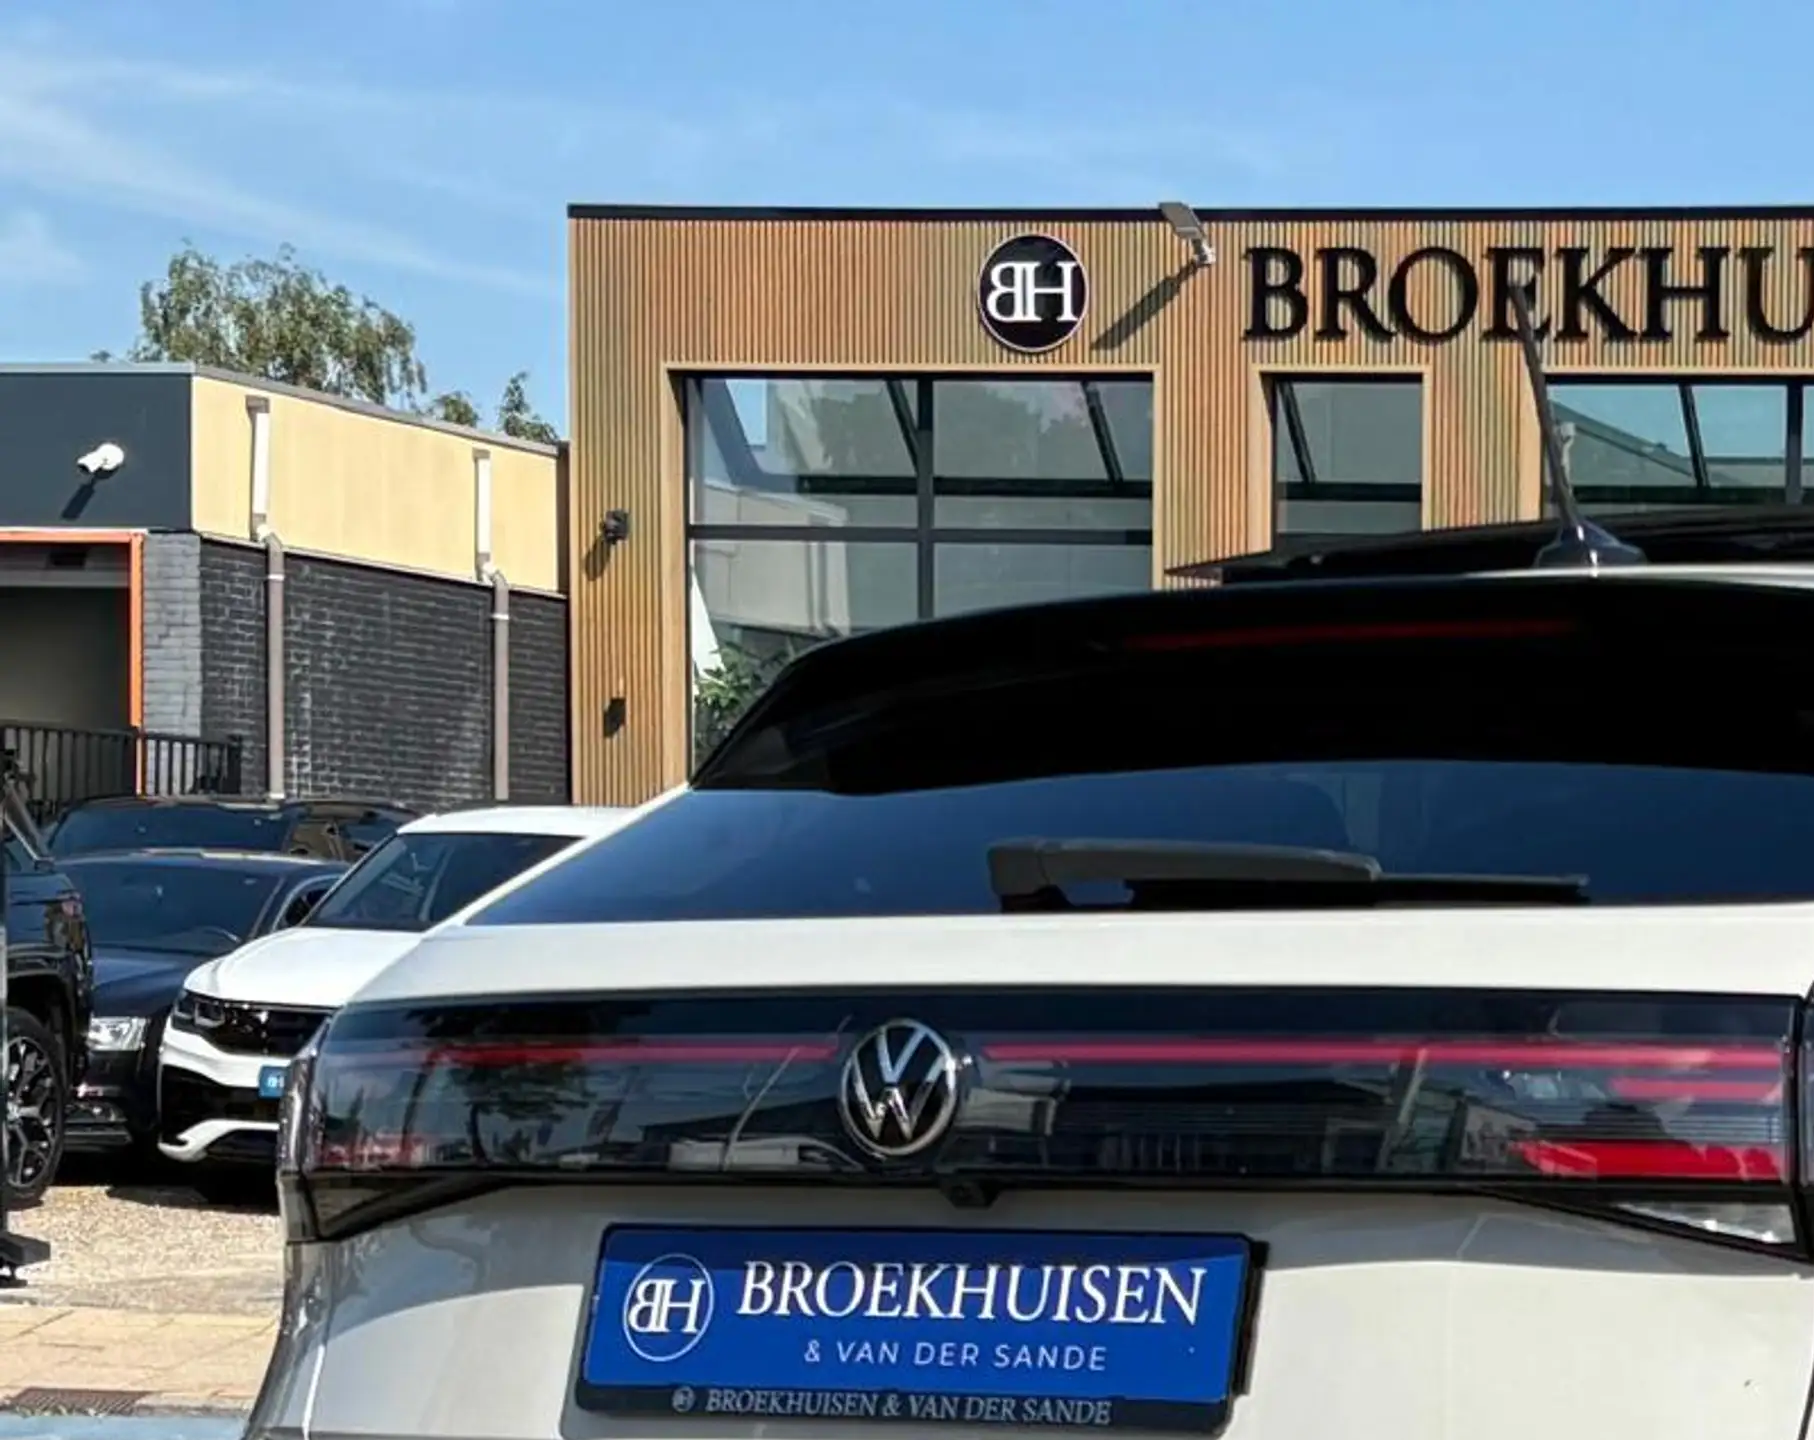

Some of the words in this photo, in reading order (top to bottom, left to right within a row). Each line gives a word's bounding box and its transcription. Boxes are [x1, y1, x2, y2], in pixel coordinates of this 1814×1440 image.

[736, 1260, 1206, 1327] BROEKHUISEN
[803, 1339, 821, 1363] &
[836, 1341, 900, 1365] VAN
[914, 1342, 980, 1367] DER
[993, 1344, 1108, 1372] SANDE
[705, 1388, 881, 1416] BROEKHUISEN
[882, 1393, 901, 1417] &
[907, 1394, 960, 1419] VAN
[964, 1397, 1018, 1422] DER
[1022, 1398, 1113, 1426] SANDE
